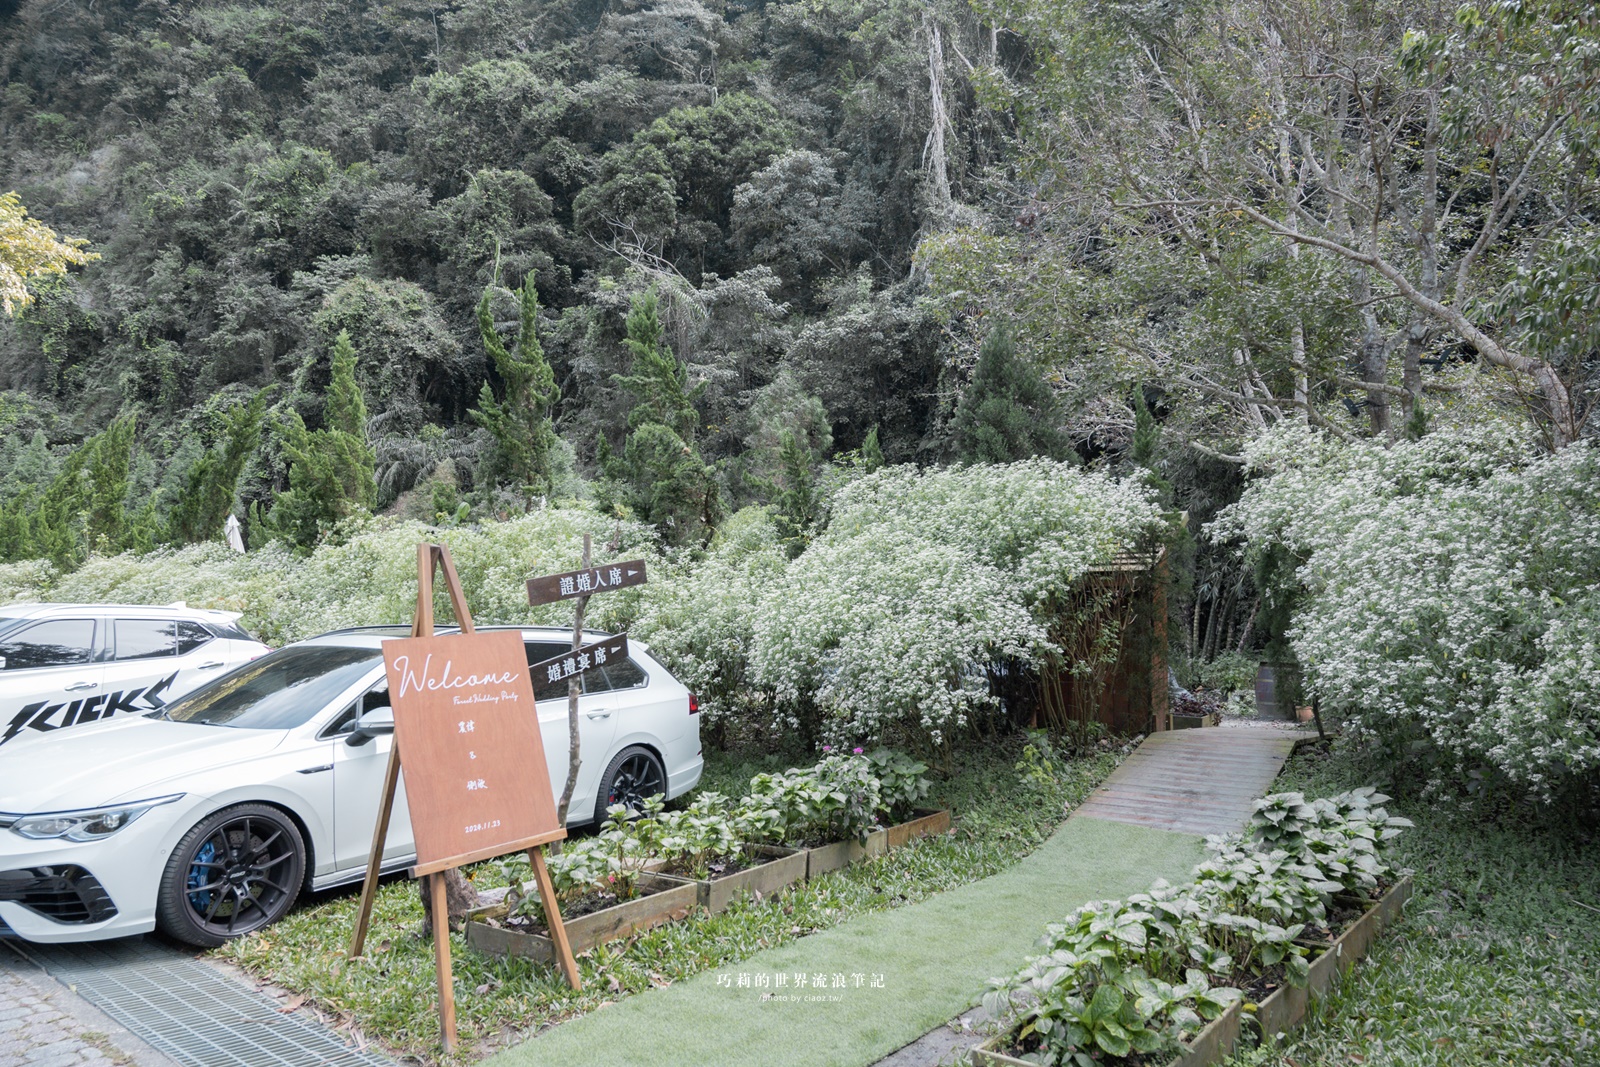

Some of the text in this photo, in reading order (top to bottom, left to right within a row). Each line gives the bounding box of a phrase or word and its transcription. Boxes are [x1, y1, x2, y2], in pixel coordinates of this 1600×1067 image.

[559, 567, 622, 596] 證婚人席
[393, 653, 520, 699] Welcome
[547, 647, 607, 684] 婚禮宴席
[0, 669, 180, 746] KICKS
[500, 690, 519, 702] Party
